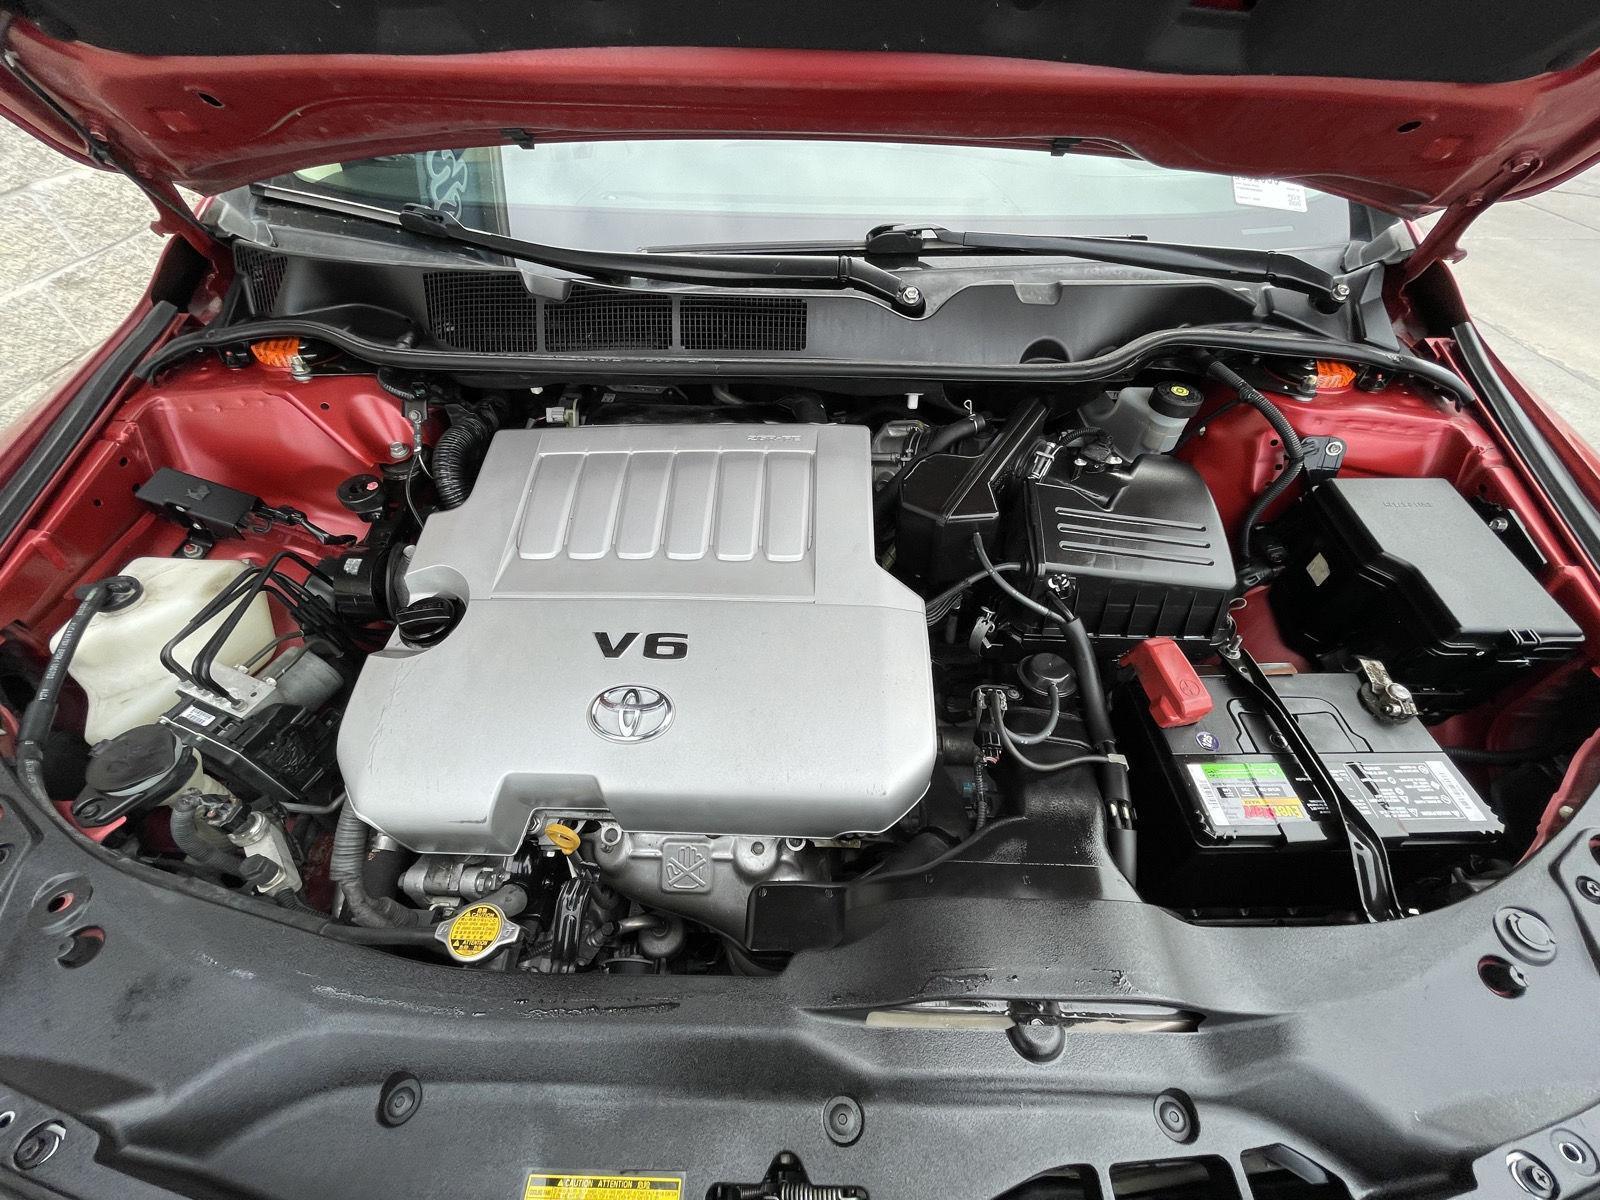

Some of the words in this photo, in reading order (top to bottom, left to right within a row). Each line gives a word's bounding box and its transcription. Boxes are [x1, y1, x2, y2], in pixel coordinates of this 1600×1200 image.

[592, 631, 689, 660] V6
[565, 1178, 594, 1188] CAUTION
[597, 1179, 633, 1189] ATTENTION
